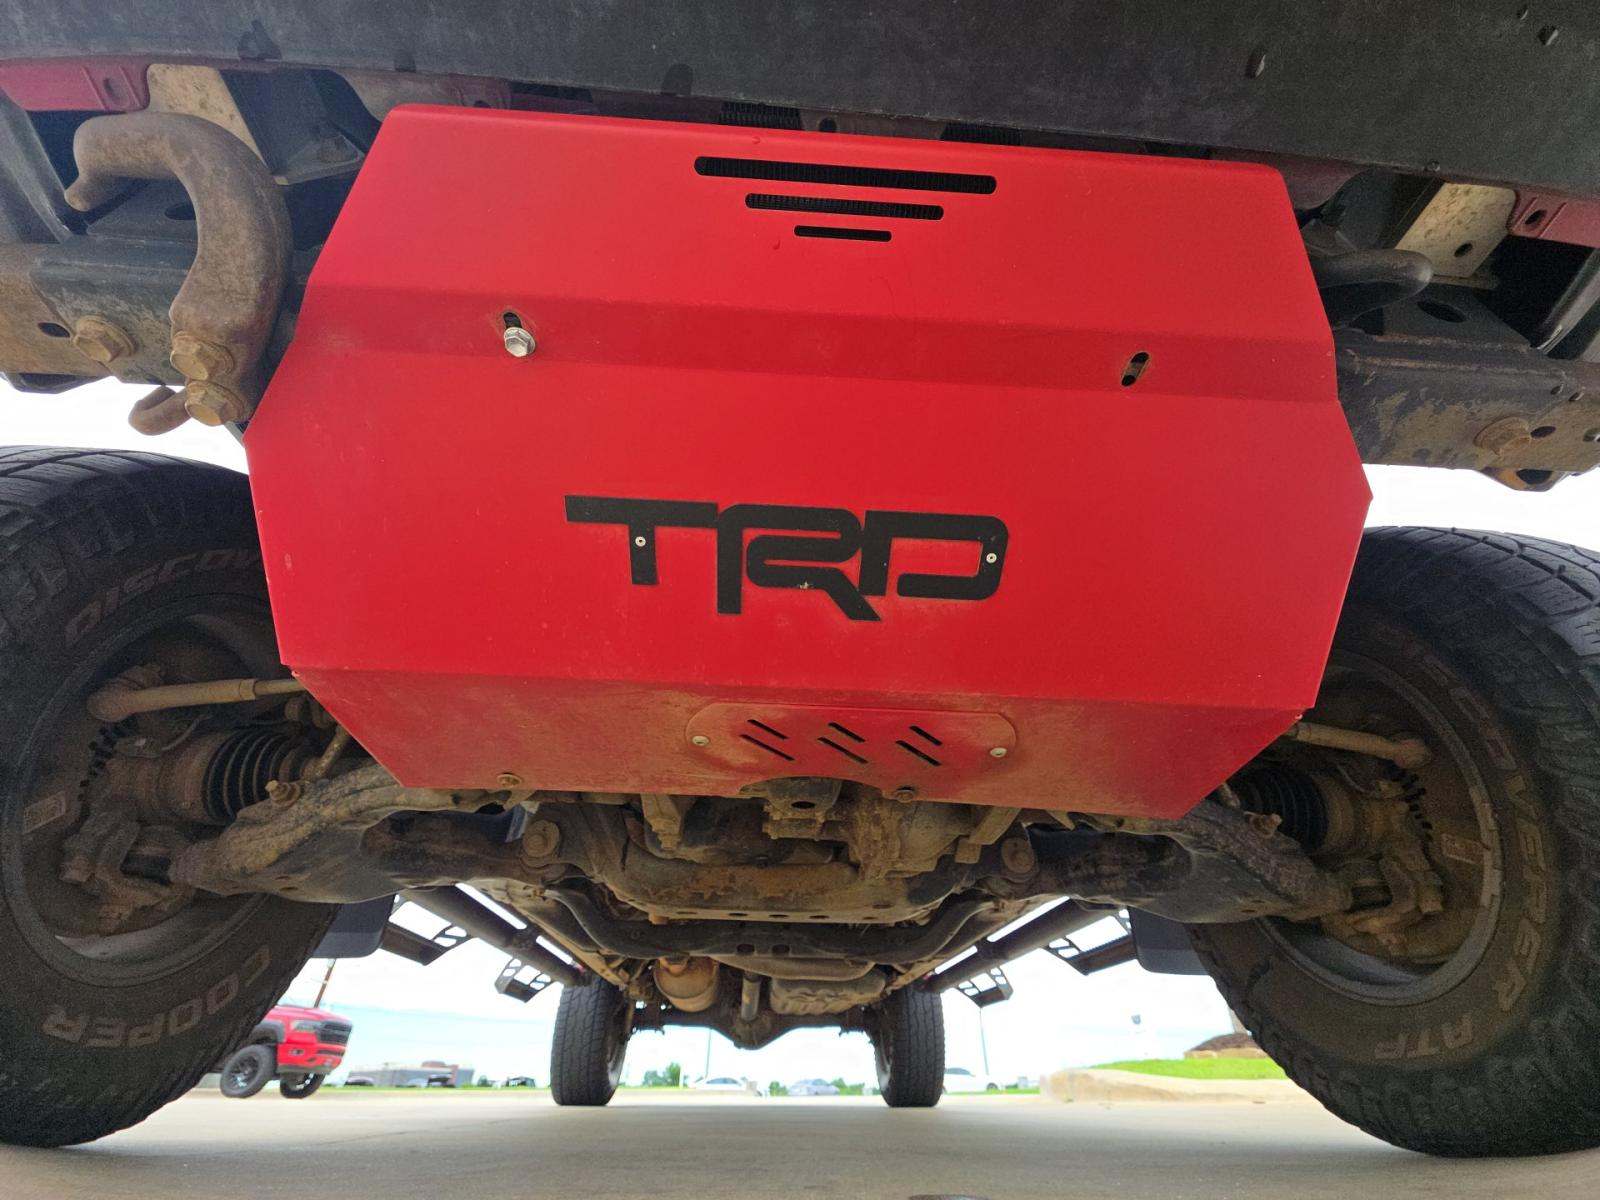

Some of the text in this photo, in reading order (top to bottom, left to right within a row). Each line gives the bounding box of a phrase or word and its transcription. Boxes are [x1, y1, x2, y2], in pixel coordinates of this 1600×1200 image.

[65, 548, 262, 648] DISCOV
[565, 495, 1009, 622] TRD
[42, 944, 271, 1048] COOPER
